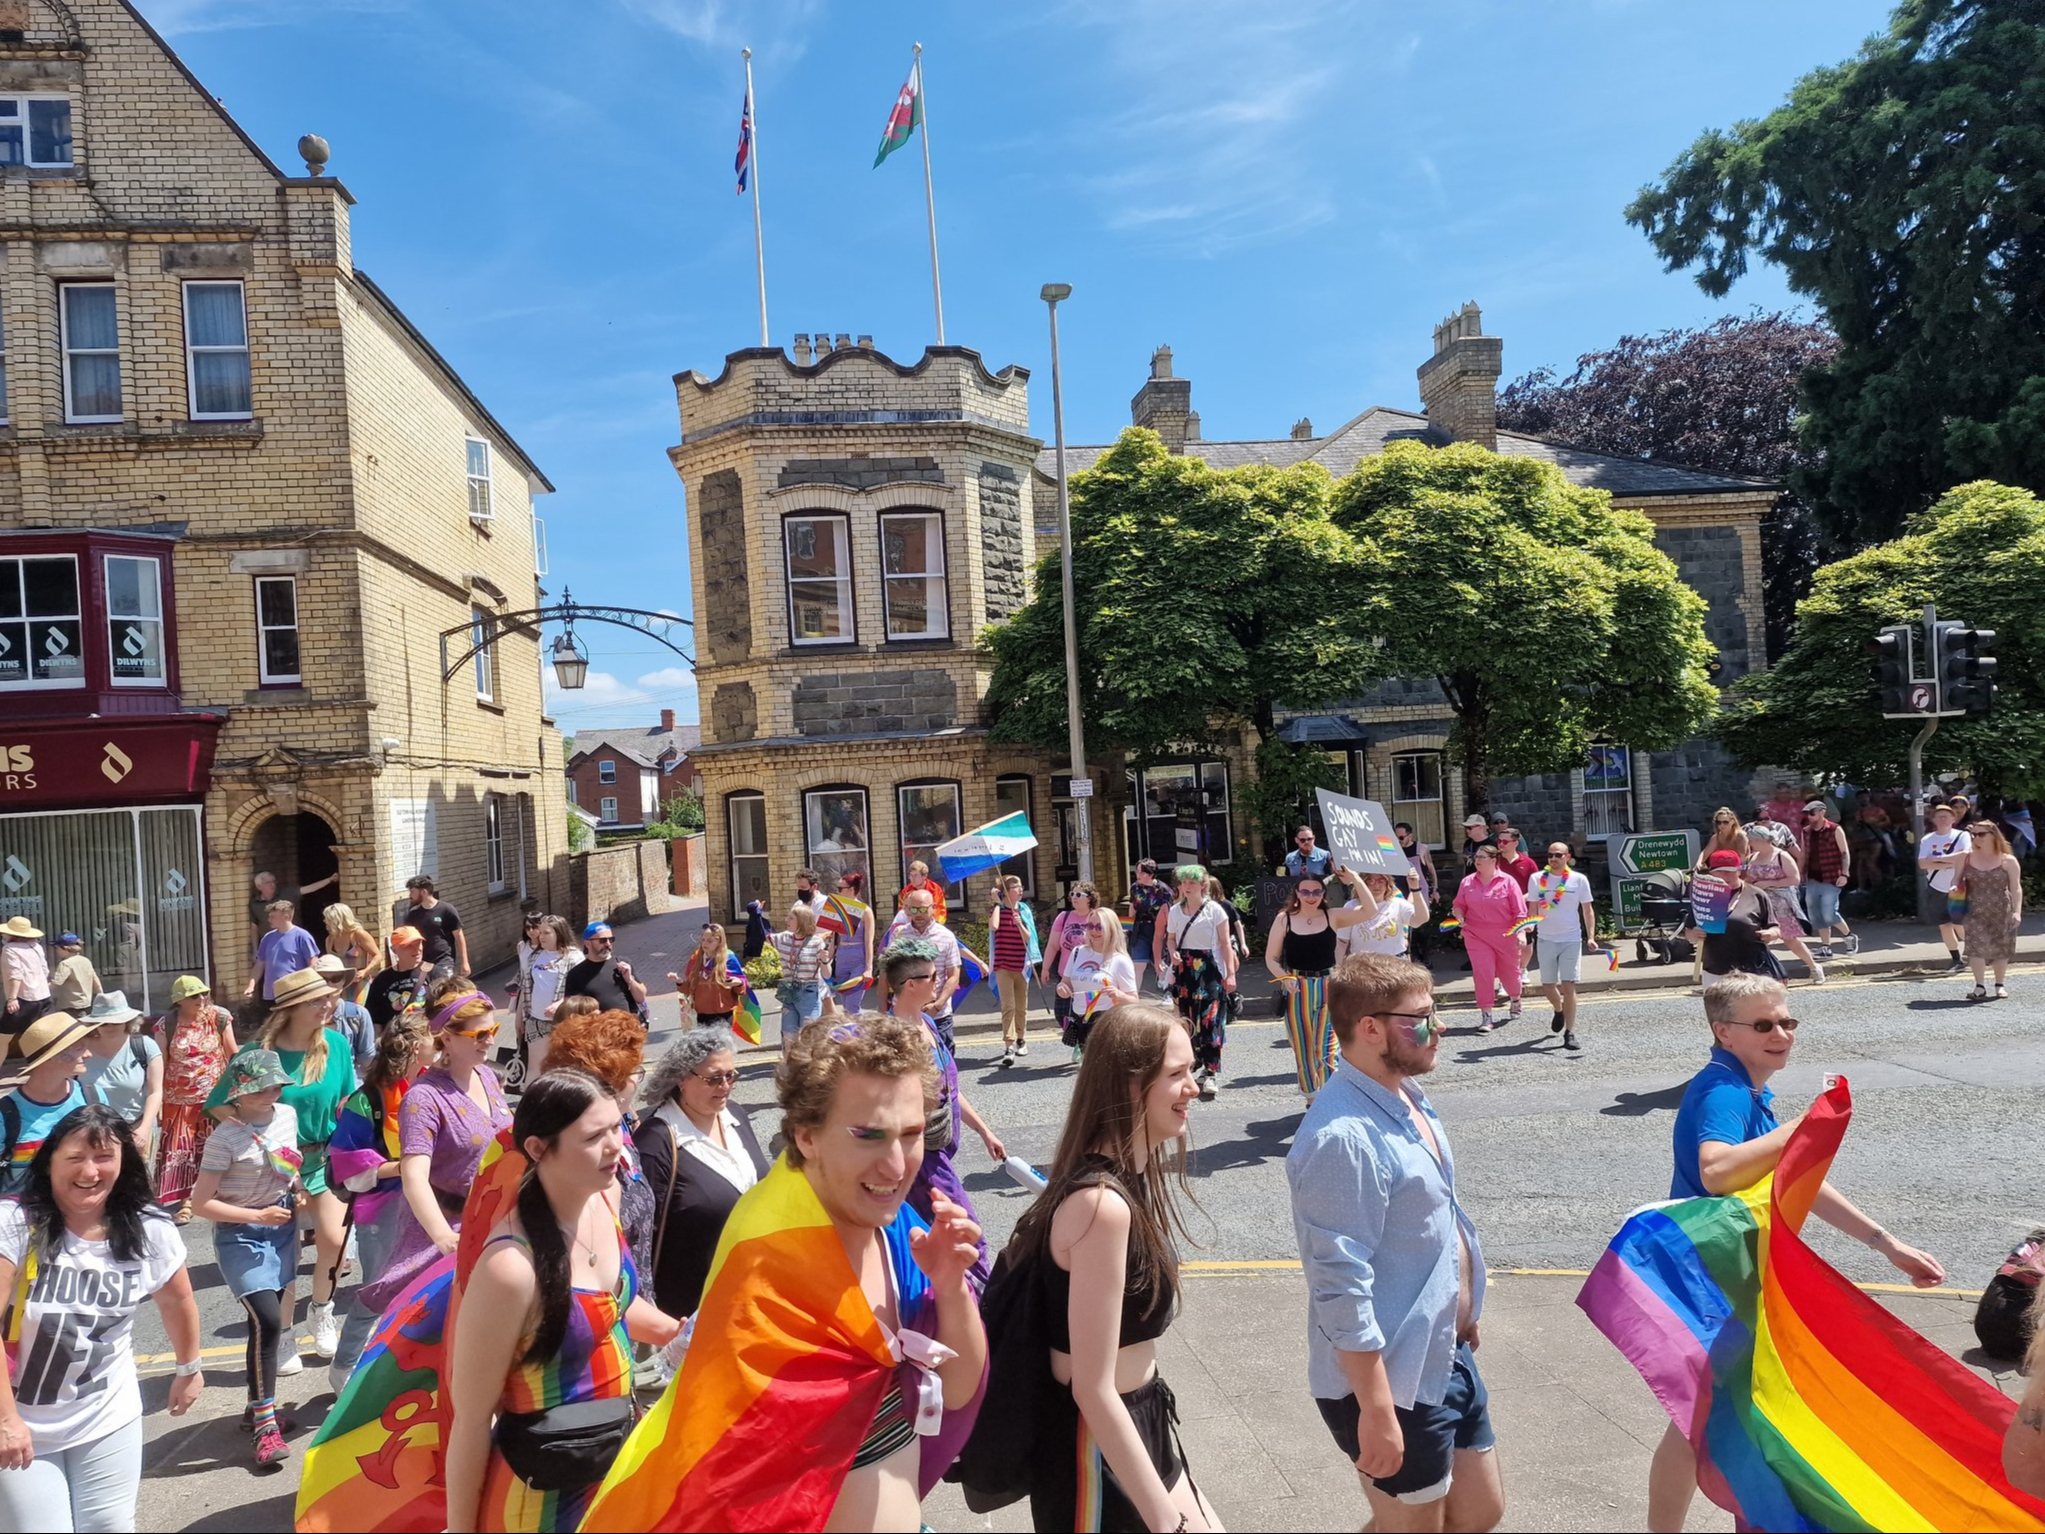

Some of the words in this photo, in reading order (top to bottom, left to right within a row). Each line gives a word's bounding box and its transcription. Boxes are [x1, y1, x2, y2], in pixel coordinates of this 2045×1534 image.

[0, 660, 20, 669] YNS
[39, 658, 78, 667] DILWYNS
[116, 657, 157, 666] DILWYNS
[0, 773, 37, 790] RS
[1327, 802, 1374, 832] SOUNDS
[1332, 826, 1358, 848] GAY
[1638, 838, 1685, 849] Drenewydd
[1639, 850, 1678, 859] Newtown
[26, 1264, 141, 1308] HOOSE
[14, 1313, 128, 1406] IFE
